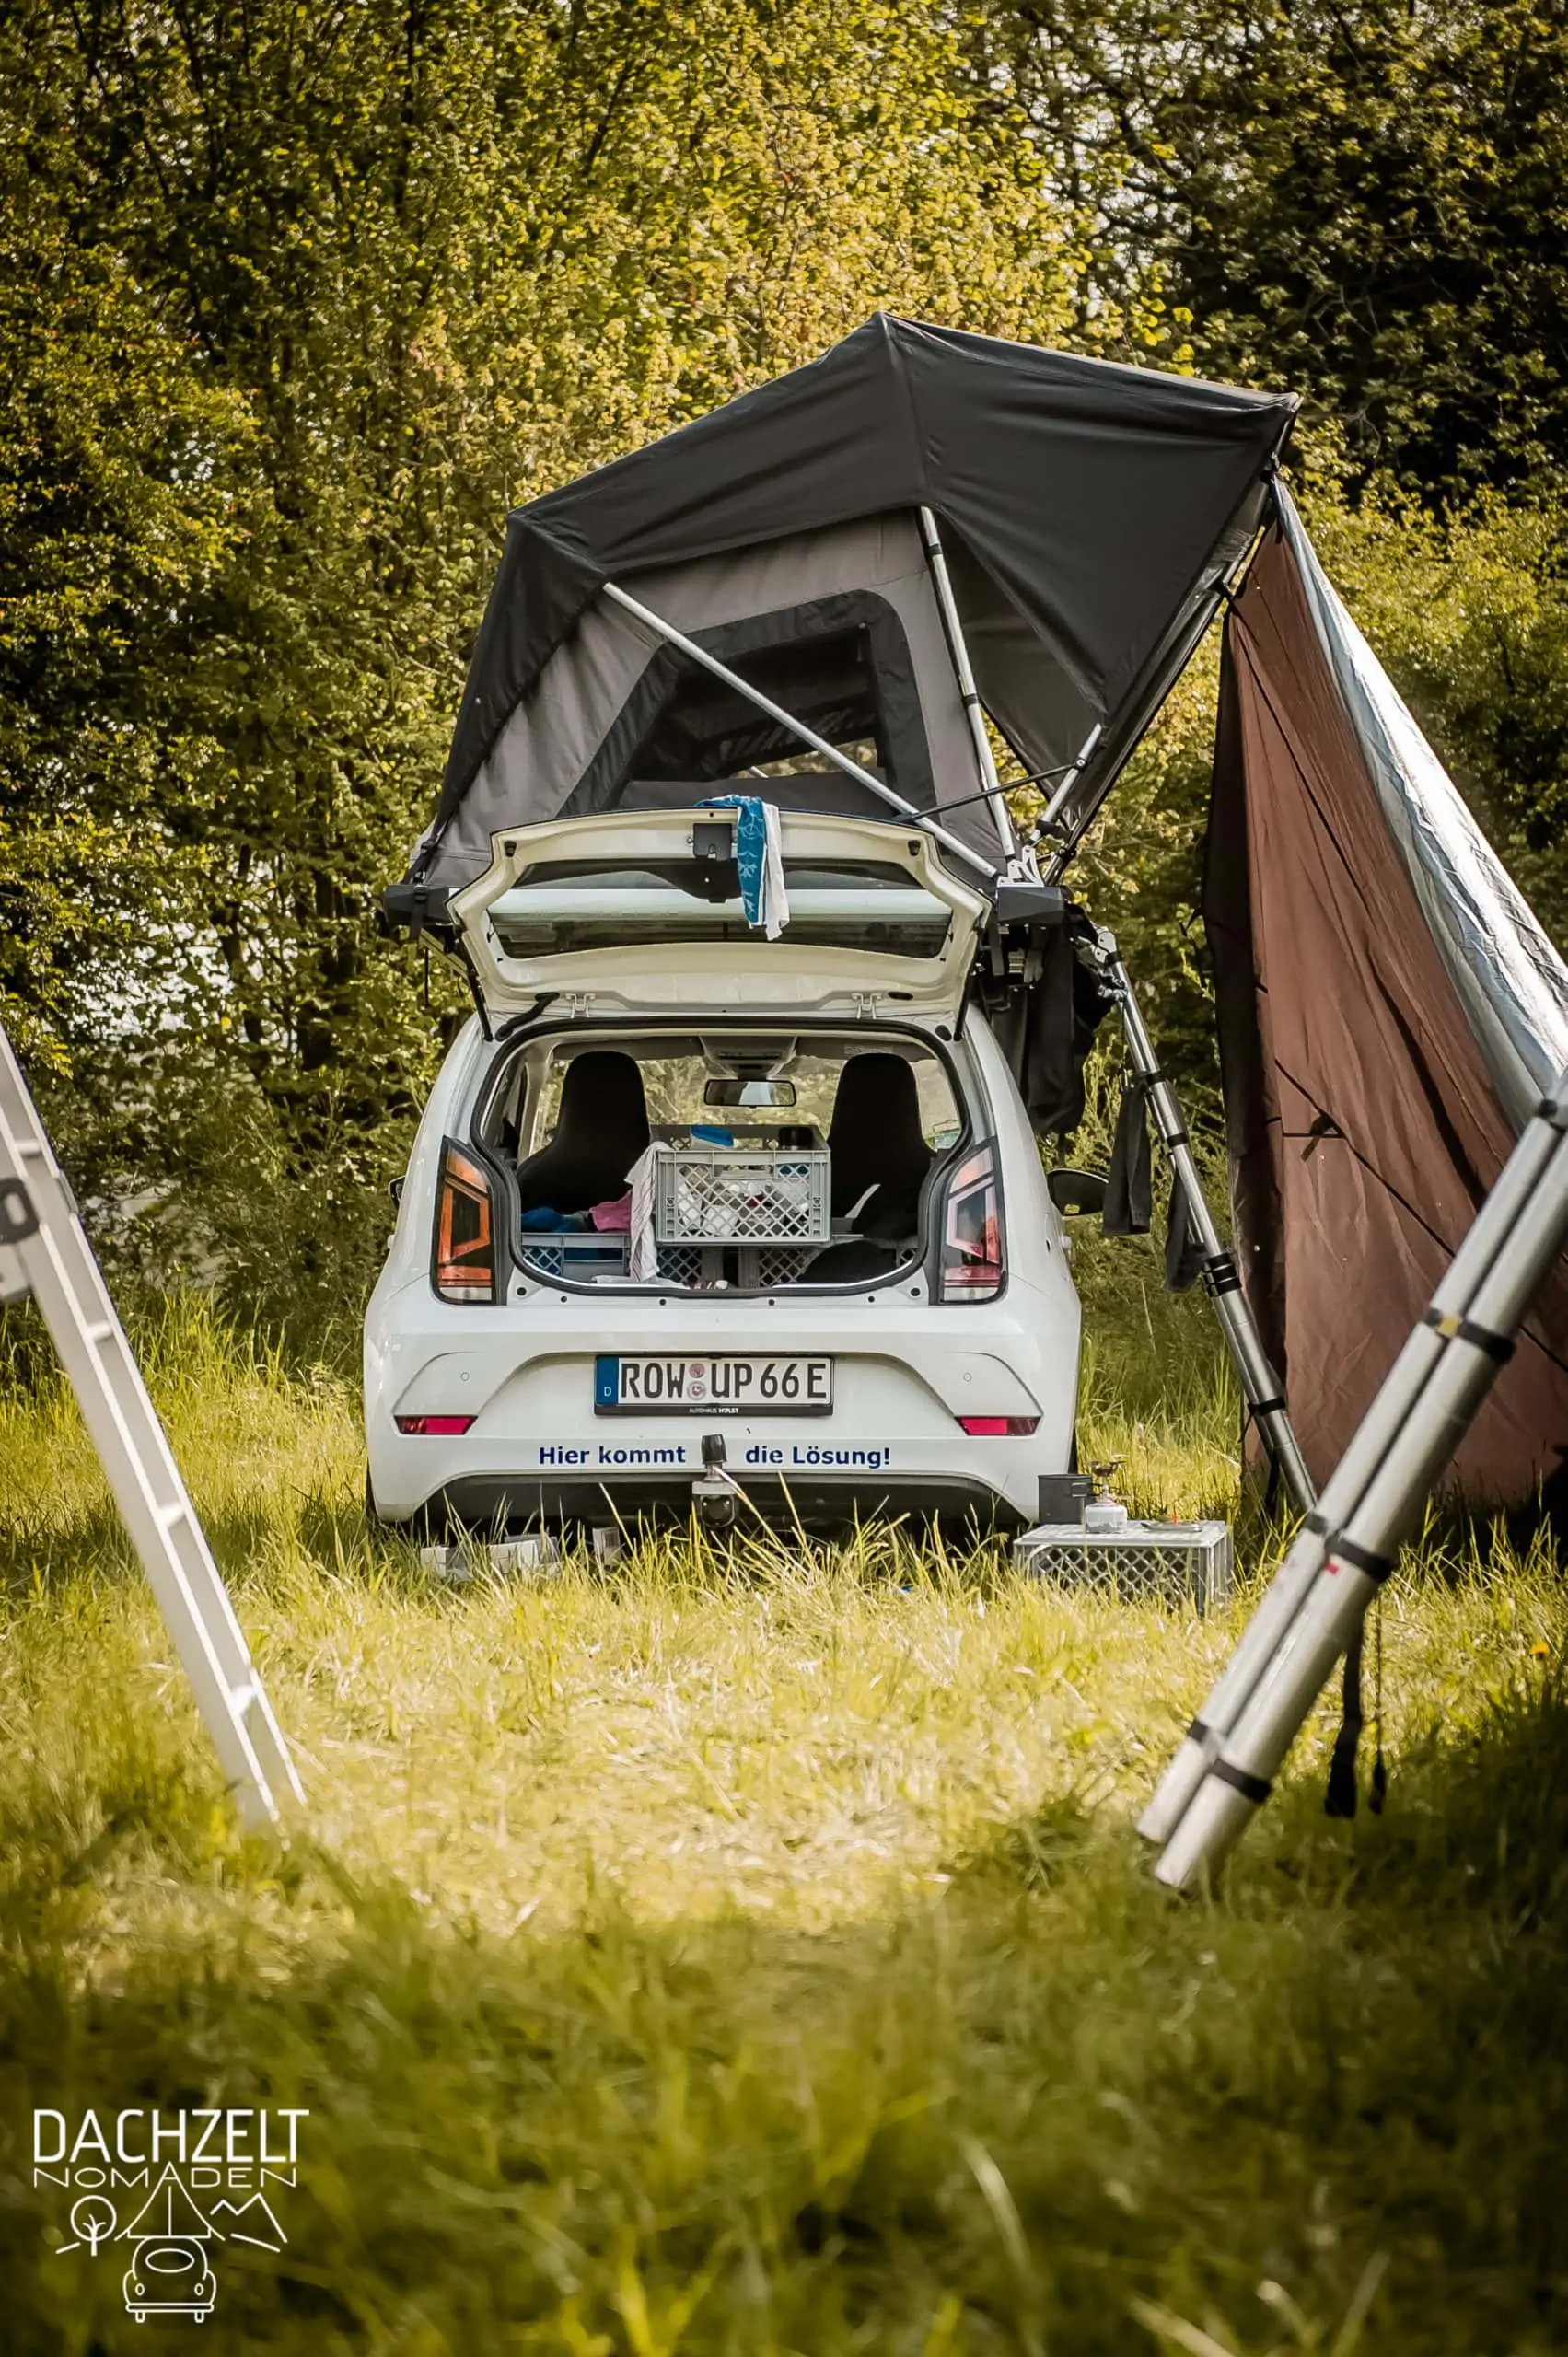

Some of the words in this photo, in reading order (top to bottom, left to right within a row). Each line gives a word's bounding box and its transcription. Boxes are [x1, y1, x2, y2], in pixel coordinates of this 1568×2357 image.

[604, 1386, 612, 1397] D
[621, 1363, 686, 1398] ROW
[539, 1446, 590, 1464] Hier
[598, 1446, 686, 1464] kommt
[746, 1446, 783, 1464] die
[793, 1446, 890, 1469] Lösung!
